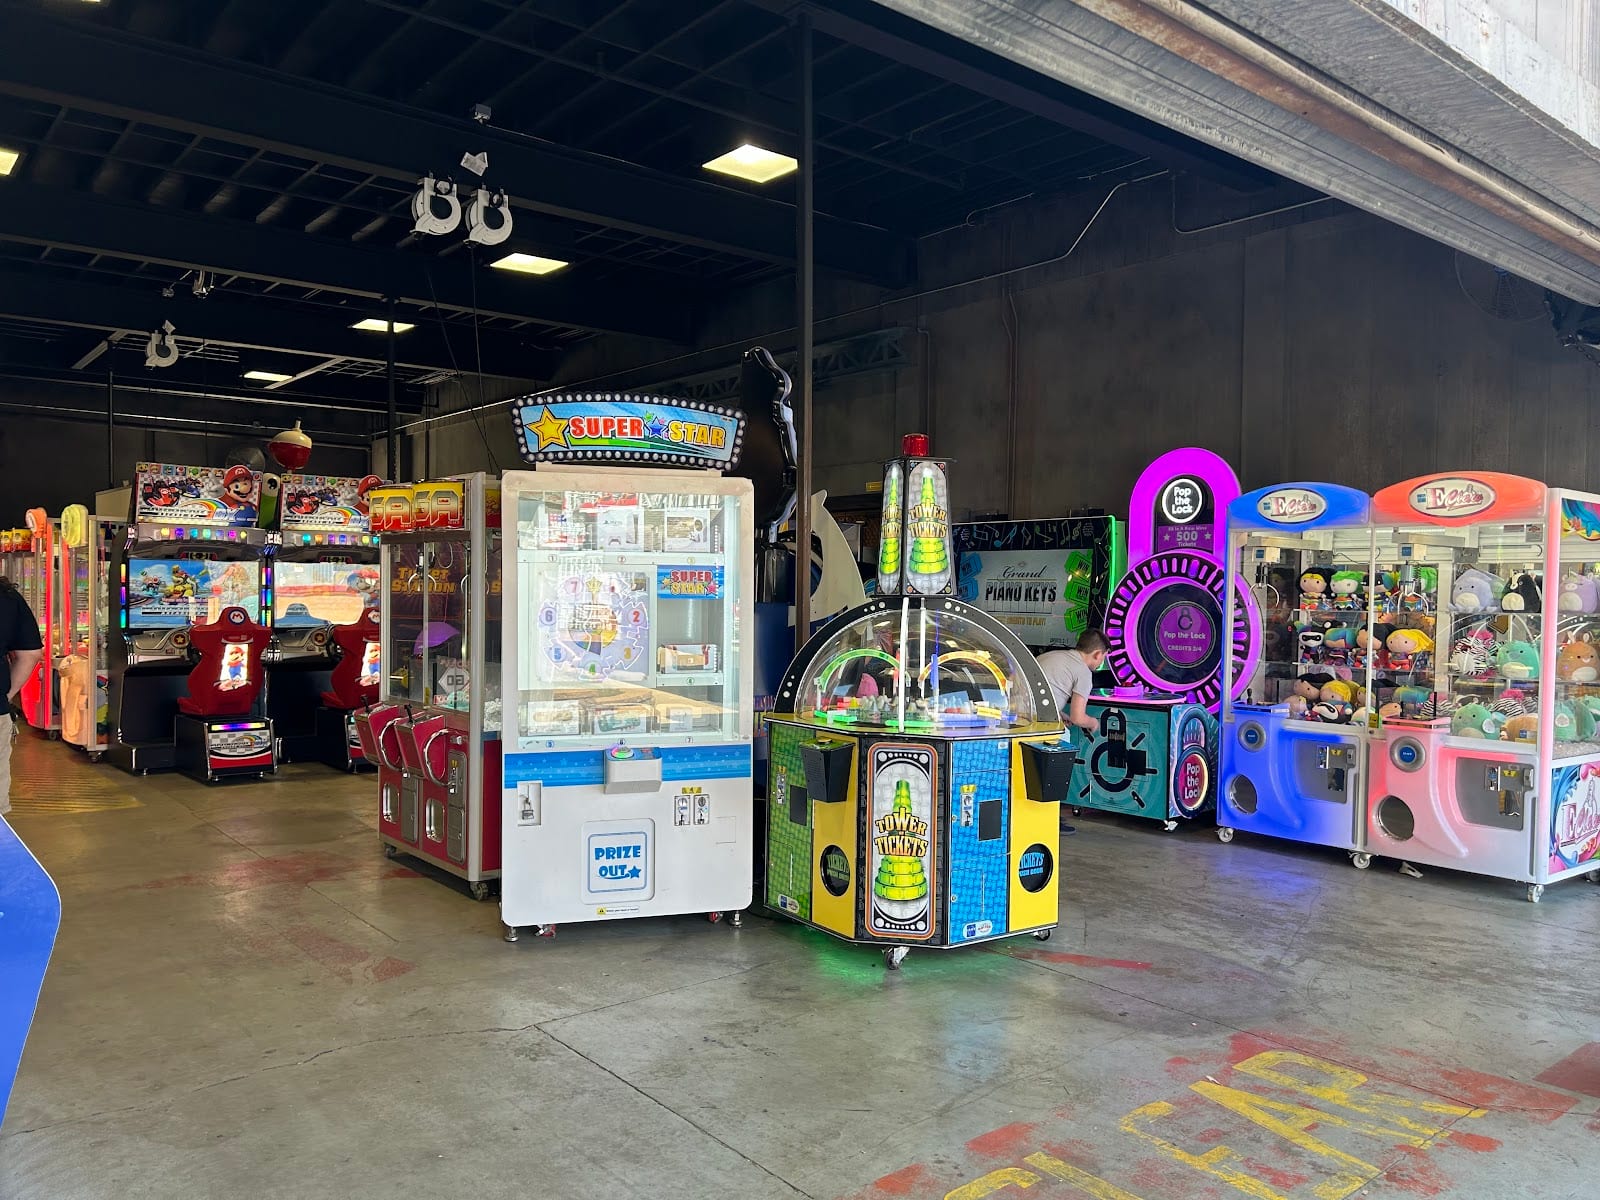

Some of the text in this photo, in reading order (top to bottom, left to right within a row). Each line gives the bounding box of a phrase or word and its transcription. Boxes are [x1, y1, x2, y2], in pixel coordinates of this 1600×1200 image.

[569, 416, 726, 448] SUPER STAR
[1174, 486, 1192, 498] Pop
[1174, 495, 1191, 506] the
[908, 498, 948, 521] TOWER
[1171, 504, 1193, 514] Lock
[907, 521, 948, 538] TICKETS
[1176, 531, 1198, 541] 500
[671, 570, 713, 583] SUPER
[1003, 565, 1047, 579] Grand
[391, 580, 456, 594] STAION
[571, 581, 578, 593] 7
[670, 582, 705, 595] STAR
[985, 582, 1057, 603] PIANO KEYS
[545, 610, 553, 622] 6
[632, 610, 640, 623] 2
[1163, 631, 1206, 640] Pop the Lock
[553, 647, 561, 660] 5
[623, 647, 632, 660] 3
[1186, 763, 1200, 776] Pop
[1186, 775, 1200, 788] the
[875, 807, 928, 836] TOWER
[874, 835, 928, 857] TICKETS
[594, 845, 641, 861] PRIZE
[1020, 852, 1044, 869] ICKETS
[598, 864, 628, 879] OUT
